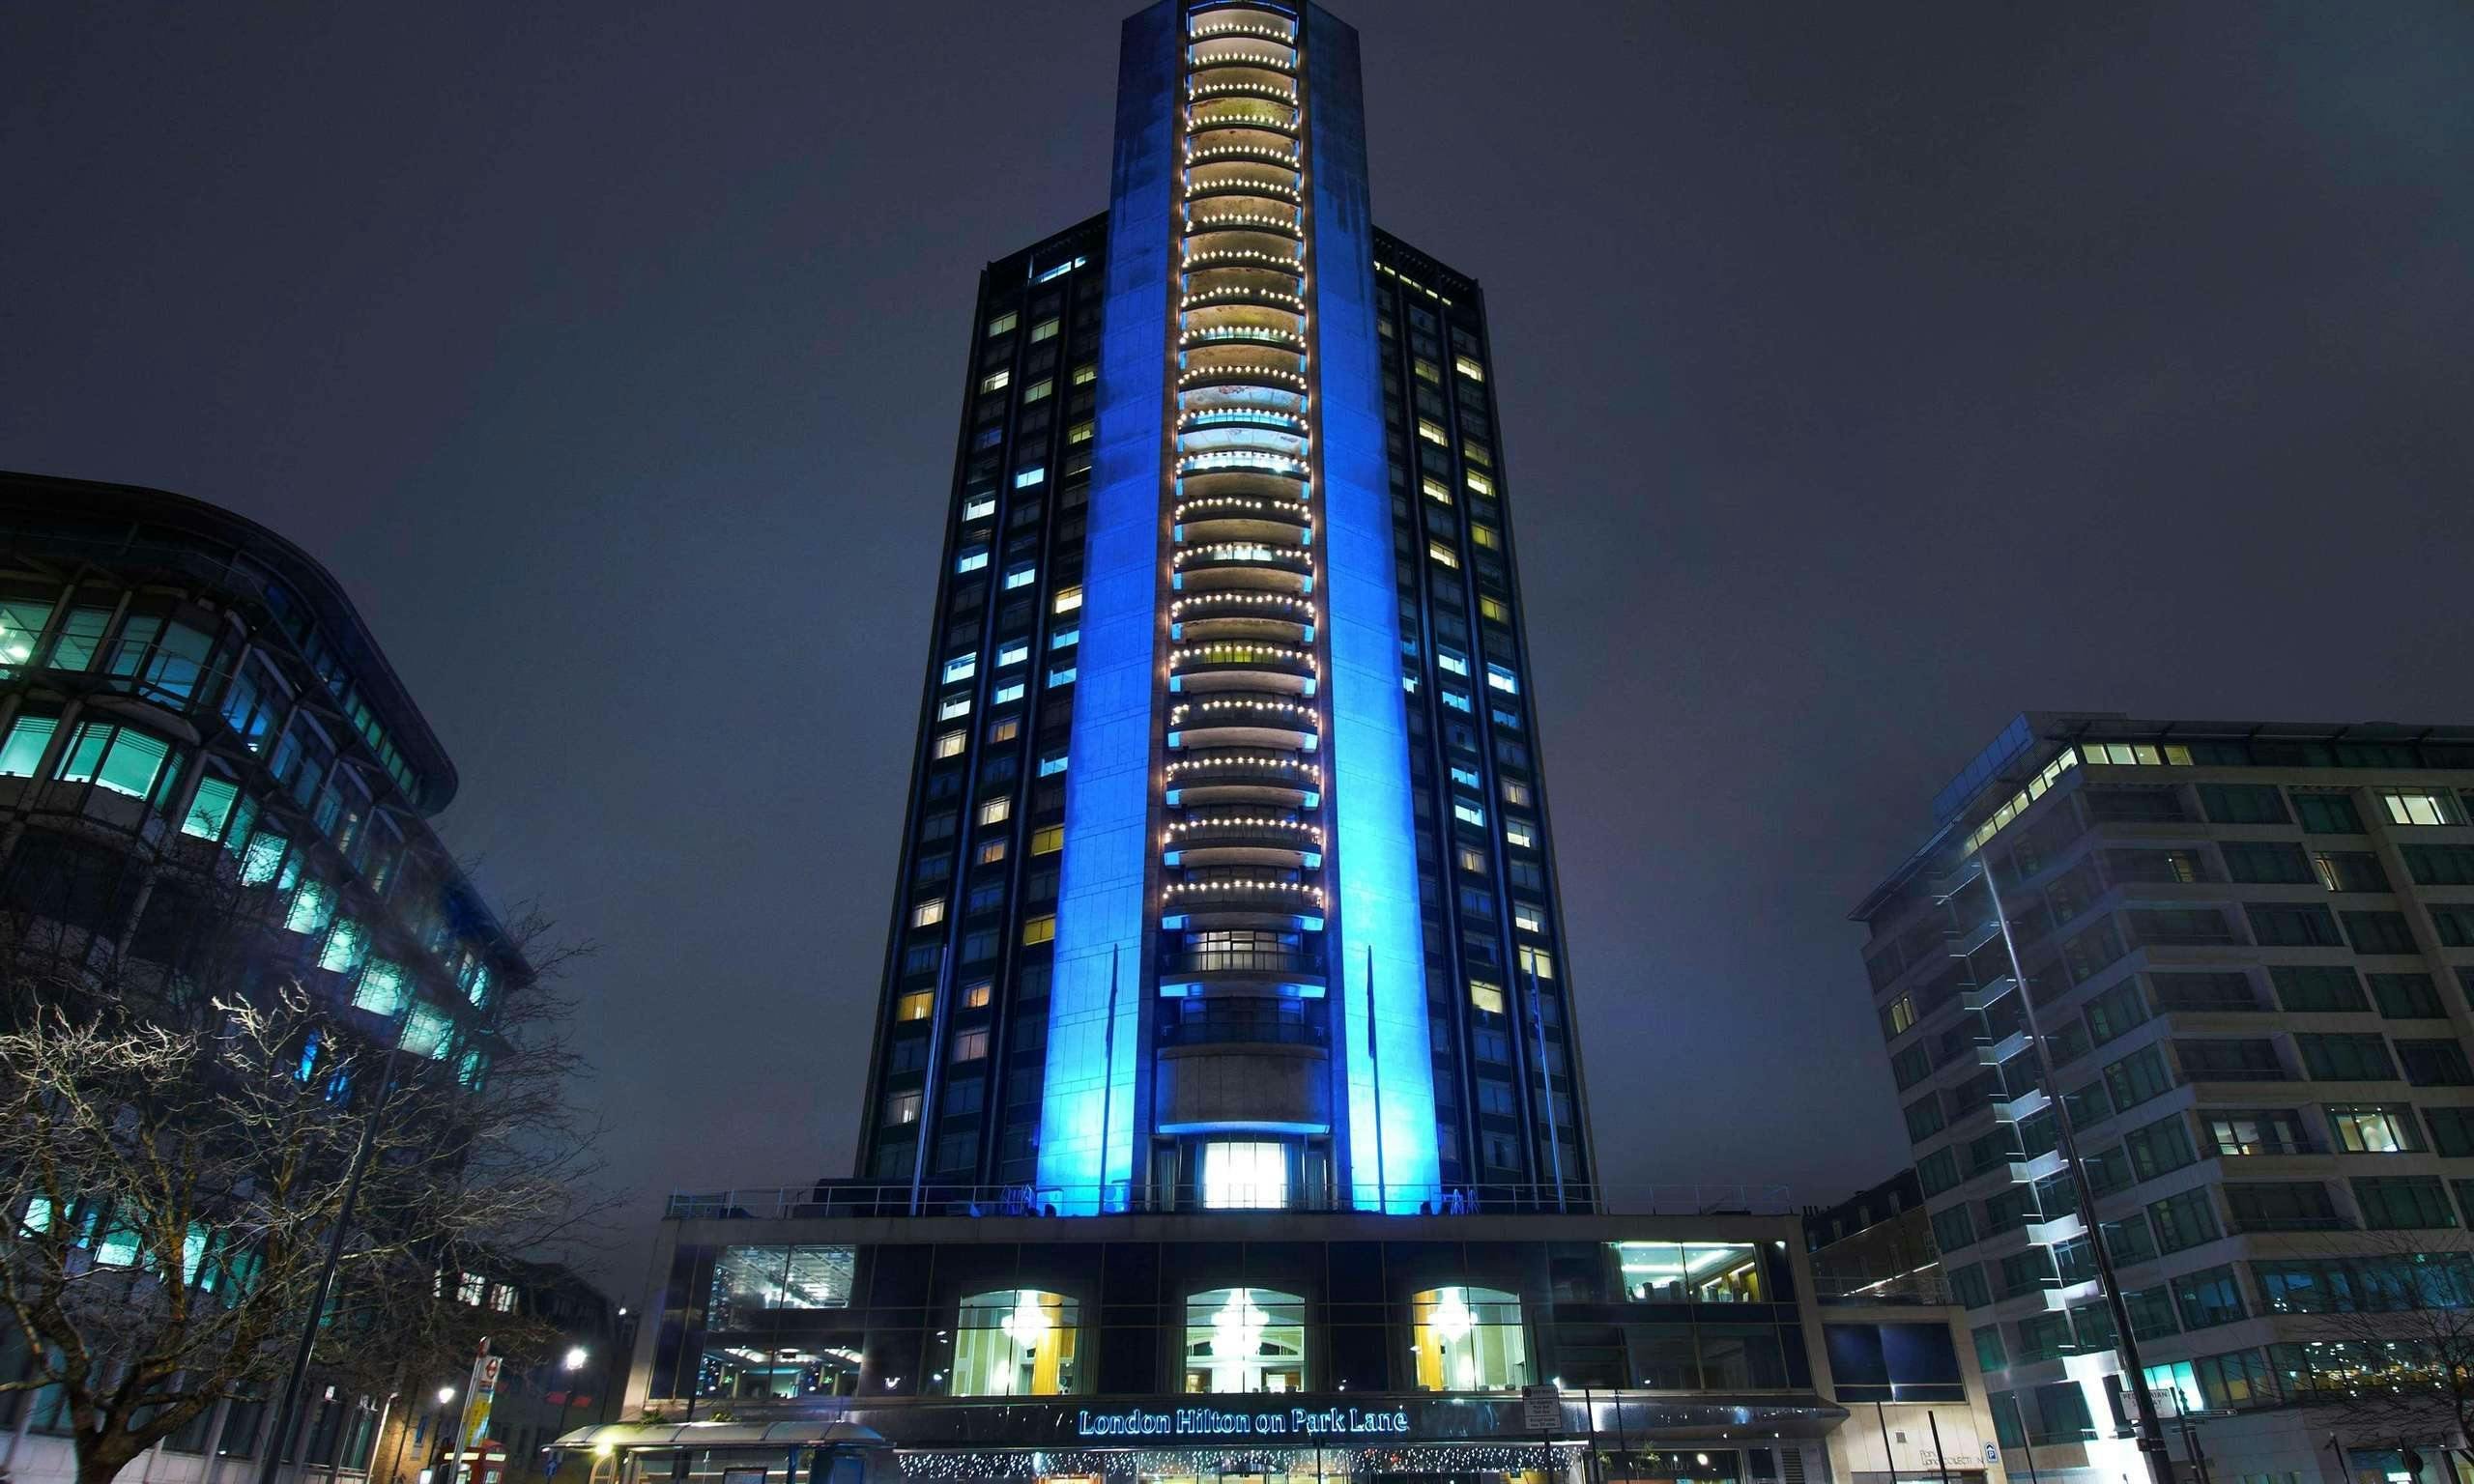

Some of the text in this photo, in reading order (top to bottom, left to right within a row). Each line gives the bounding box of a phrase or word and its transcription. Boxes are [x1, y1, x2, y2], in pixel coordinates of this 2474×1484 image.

[1079, 1407, 1408, 1435] London Hilton on Park Lane
